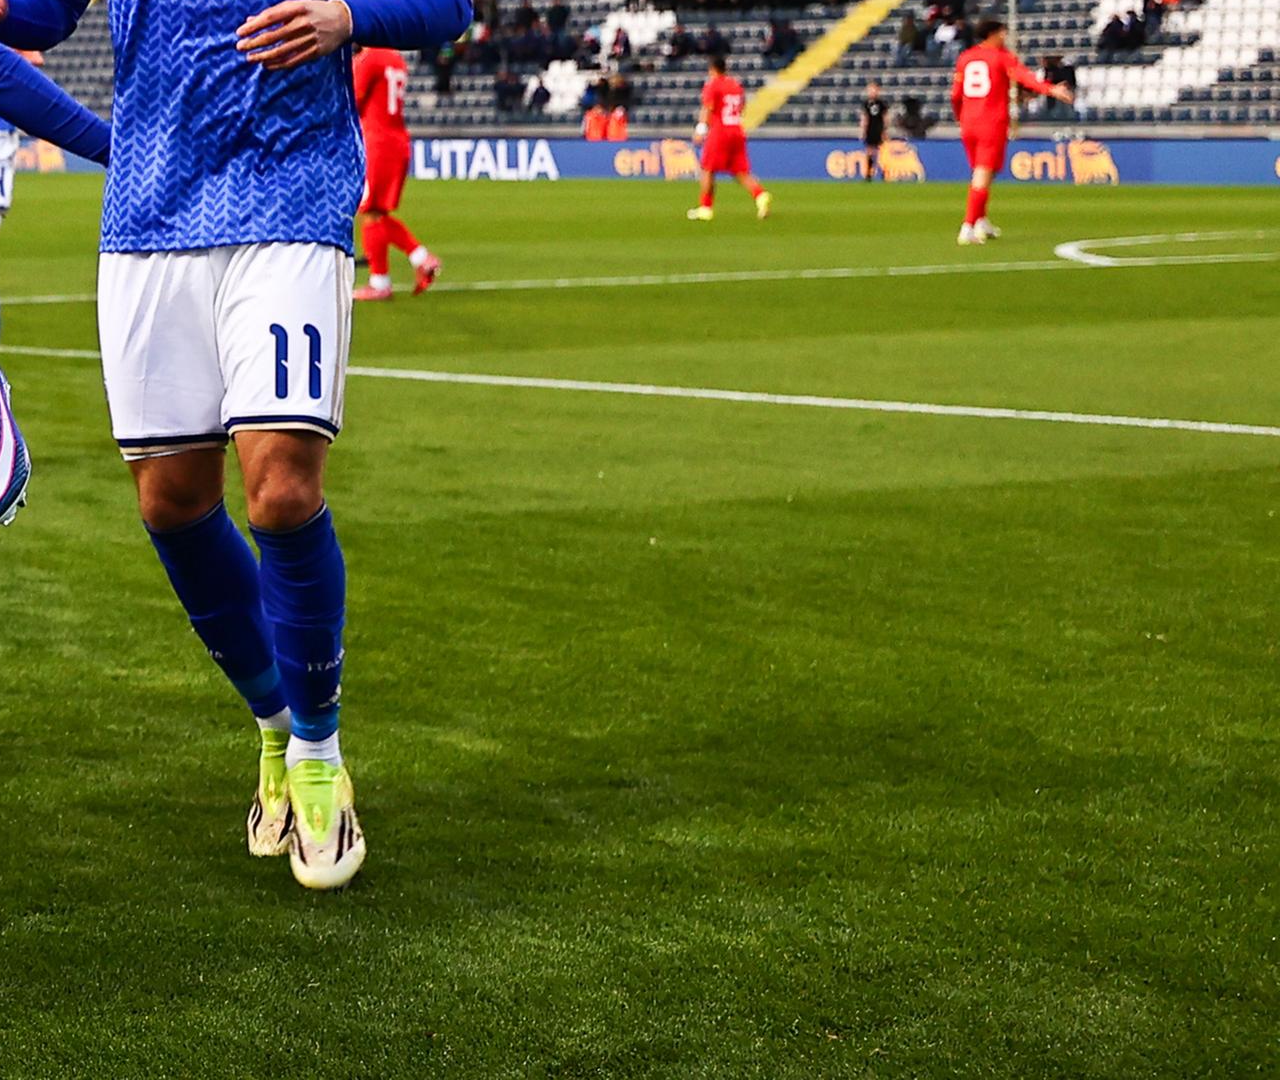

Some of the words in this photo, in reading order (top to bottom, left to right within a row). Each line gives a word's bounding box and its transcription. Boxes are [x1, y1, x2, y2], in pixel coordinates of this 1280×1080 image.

[962, 60, 992, 98] 8
[414, 139, 559, 181] L'ITALIA
[613, 143, 661, 176] eni
[825, 149, 866, 179] en
[1010, 143, 1067, 180] eni
[269, 322, 322, 400] 11
